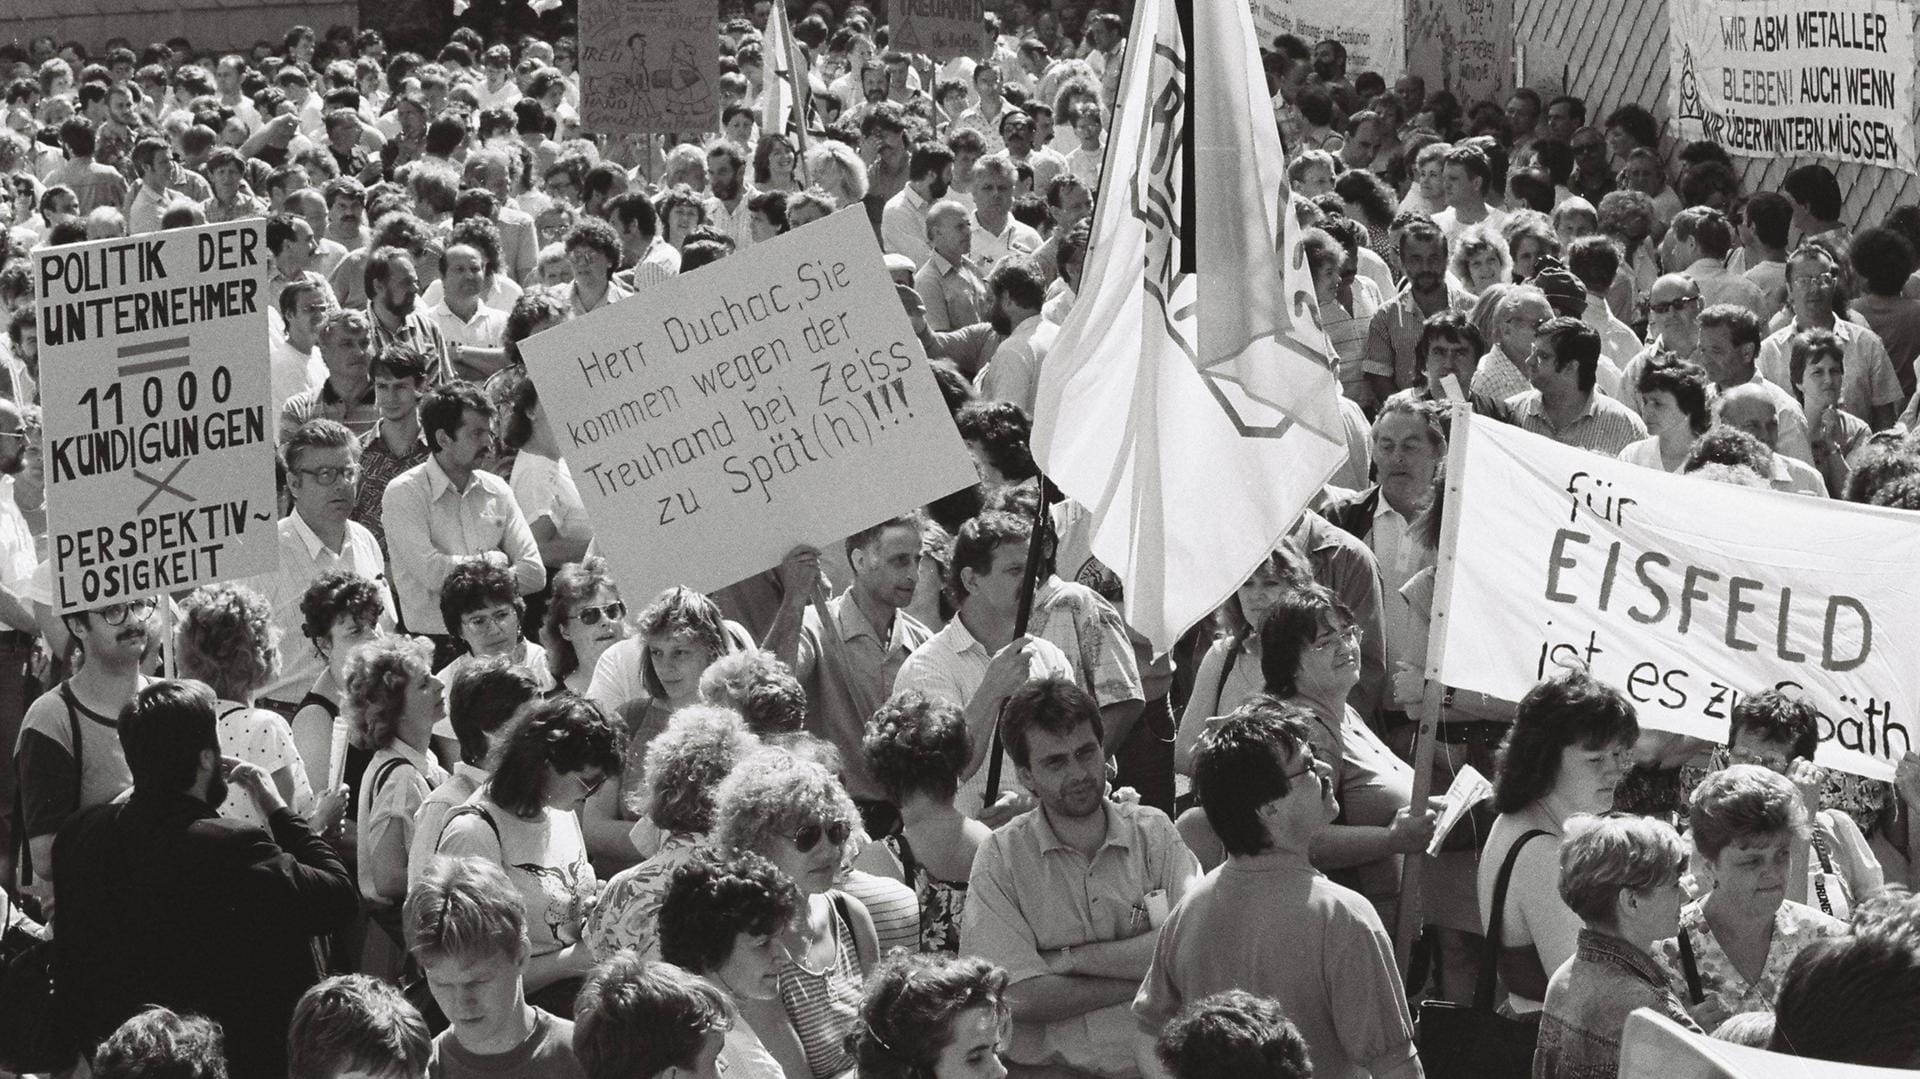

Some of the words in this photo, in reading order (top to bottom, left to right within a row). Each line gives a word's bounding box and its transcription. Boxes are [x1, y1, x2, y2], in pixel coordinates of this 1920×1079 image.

[1720, 16, 1747, 51] WIR
[1753, 15, 1789, 52] ABM
[1796, 11, 1887, 53] METALLER
[1723, 67, 1793, 106] BLEIBEN!
[1800, 67, 1841, 104] AUCH
[1844, 67, 1895, 109] WENN
[1701, 109, 1725, 145] WIR
[1828, 113, 1897, 160] MÜSSEN
[41, 239, 167, 297] POLITIK
[199, 228, 259, 273] DER
[43, 279, 257, 346] UNTERNEHMER
[578, 341, 647, 388] Herr
[797, 259, 851, 301] Sie
[567, 384, 680, 448] kommen
[691, 337, 792, 397] wegen
[803, 310, 851, 354] der
[52, 406, 264, 483] KÜNDIGUNGEN
[583, 414, 736, 497] Treuhand
[743, 386, 797, 432] bei
[811, 341, 913, 406] Zeiss
[657, 487, 701, 525] zu
[722, 378, 915, 502] Spät(h)!!!
[1566, 471, 1638, 526] für
[59, 544, 224, 608] LOSIGKEIT
[1545, 528, 1872, 671] EISFELD
[1627, 662, 1689, 709] es
